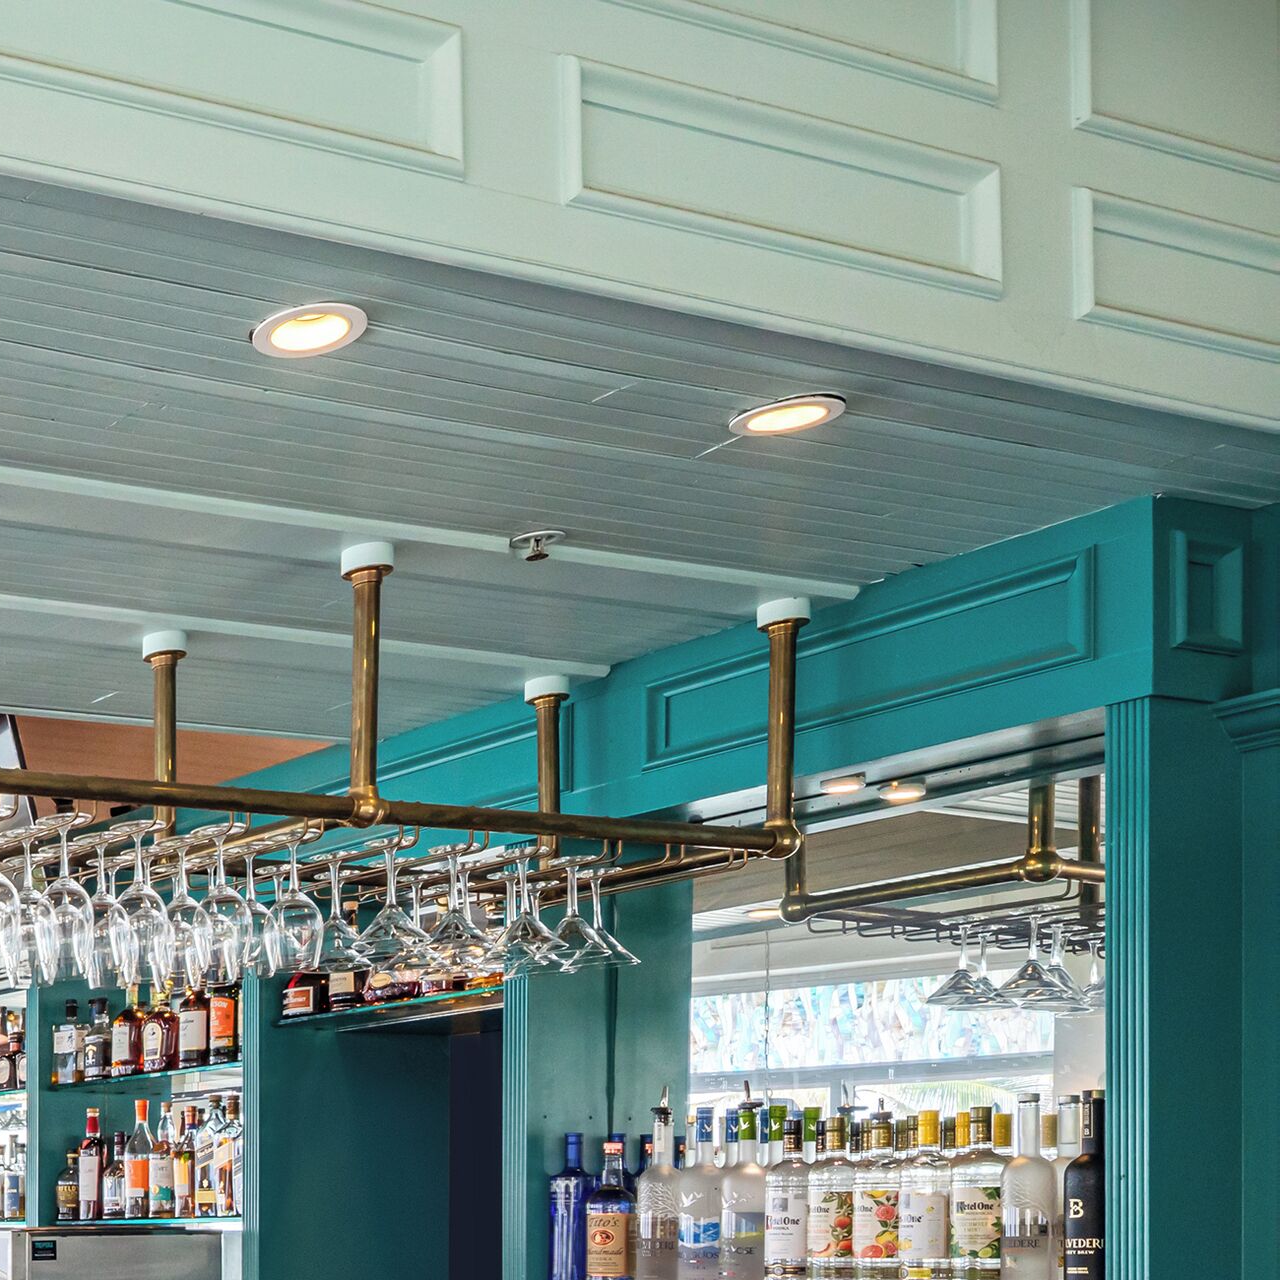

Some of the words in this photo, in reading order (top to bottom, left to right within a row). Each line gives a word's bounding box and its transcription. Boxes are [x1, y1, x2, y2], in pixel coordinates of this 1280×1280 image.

[977, 1202, 994, 1210] One
[589, 1217, 618, 1228] Tito's
[783, 1216, 800, 1226] One
